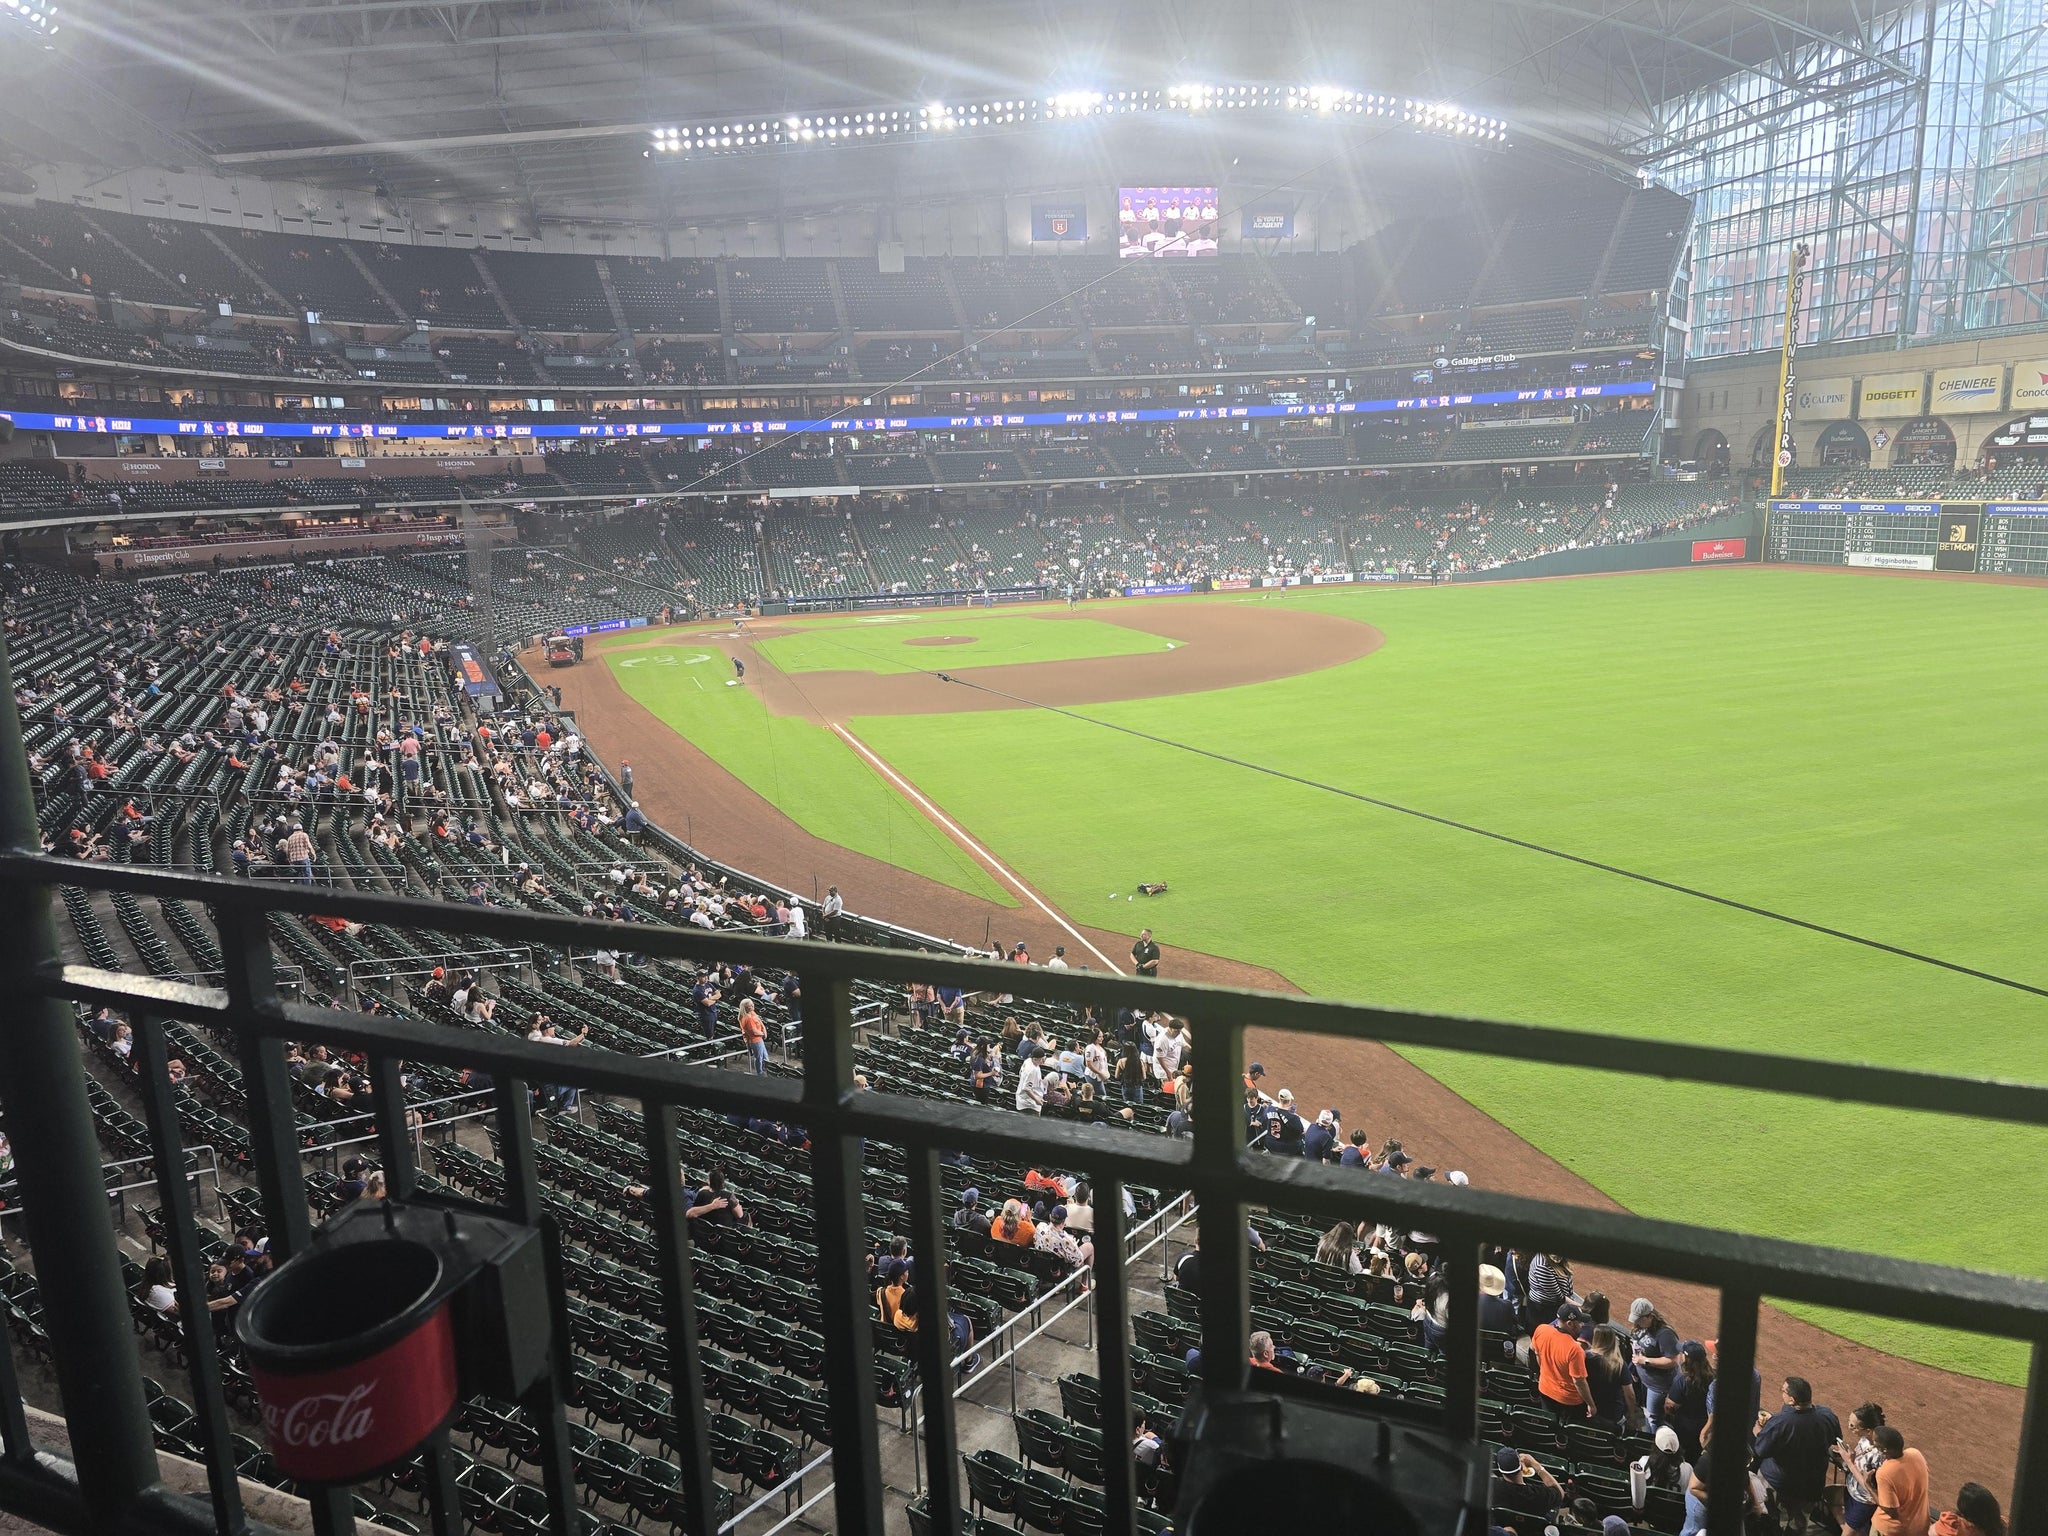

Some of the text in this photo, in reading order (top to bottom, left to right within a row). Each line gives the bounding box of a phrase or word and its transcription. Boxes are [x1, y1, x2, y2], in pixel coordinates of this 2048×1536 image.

[1451, 354, 1516, 366] Gallagher Club
[1938, 378, 1997, 391] CHENIERE
[1517, 390, 1538, 400] NYY
[1581, 386, 1602, 396] HOU
[1866, 390, 1917, 400] DOGGETT
[1396, 399, 1415, 408] NYY
[1454, 395, 1473, 404] HOU
[1812, 394, 1845, 404] CALPINE
[1177, 410, 1195, 418] NYY
[1231, 408, 1248, 416] HOU
[1287, 406, 1304, 414] NYY
[1339, 403, 1356, 411] HOU
[950, 417, 969, 426] NYY
[1007, 415, 1025, 424] HOU
[1066, 414, 1084, 422] NYY
[1120, 412, 1138, 420] HOU
[54, 417, 72, 428] NYY
[111, 420, 132, 431] HOU
[179, 422, 197, 433] NYY
[243, 424, 264, 434] HOU
[579, 426, 599, 434] NYY
[642, 425, 661, 433] HOU
[707, 424, 726, 433] NYY
[768, 422, 787, 431] HOU
[831, 421, 850, 429] NYY
[889, 419, 908, 428] HOU
[312, 425, 333, 435] NYY
[378, 426, 398, 435] HOU
[447, 426, 468, 435] NYY
[511, 427, 532, 435] HOU
[1939, 543, 1975, 552] BETMGM
[143, 550, 190, 563] Insperity Club
[1702, 552, 1734, 560] Budweiser
[1270, 1120, 1282, 1138] 2
